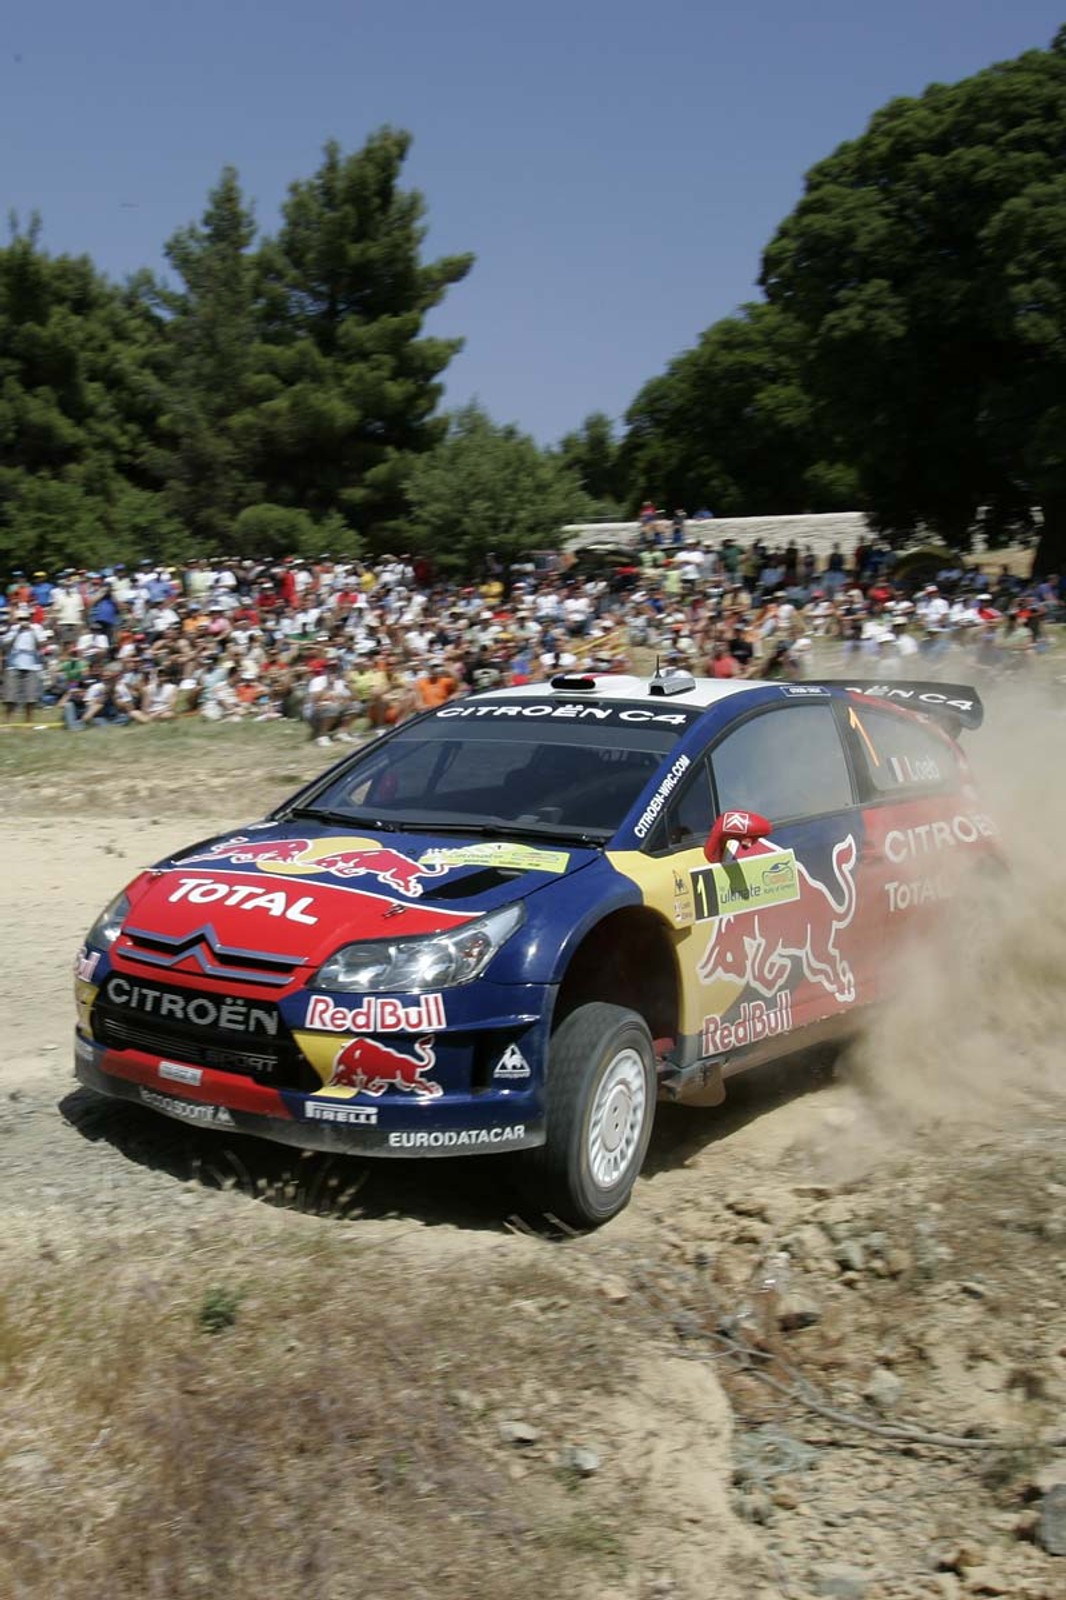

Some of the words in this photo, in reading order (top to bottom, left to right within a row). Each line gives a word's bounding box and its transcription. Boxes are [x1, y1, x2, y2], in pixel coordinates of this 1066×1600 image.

[436, 704, 613, 719] CITROËN
[618, 710, 688, 725] C4
[844, 685, 915, 698] ËN
[918, 693, 974, 711] C4
[633, 754, 691, 838] CITROEN-WRC.COM
[168, 878, 319, 925] TOTAL
[697, 874, 708, 918] 1
[884, 874, 953, 912] TOTAL
[107, 978, 279, 1035] CITROËN
[305, 994, 376, 1032] Red
[376, 993, 447, 1032] Bull
[702, 1003, 749, 1057] Red
[749, 989, 793, 1042] Bull
[304, 1101, 378, 1125] PIRELLI
[388, 1124, 526, 1148] EURODATACAR
